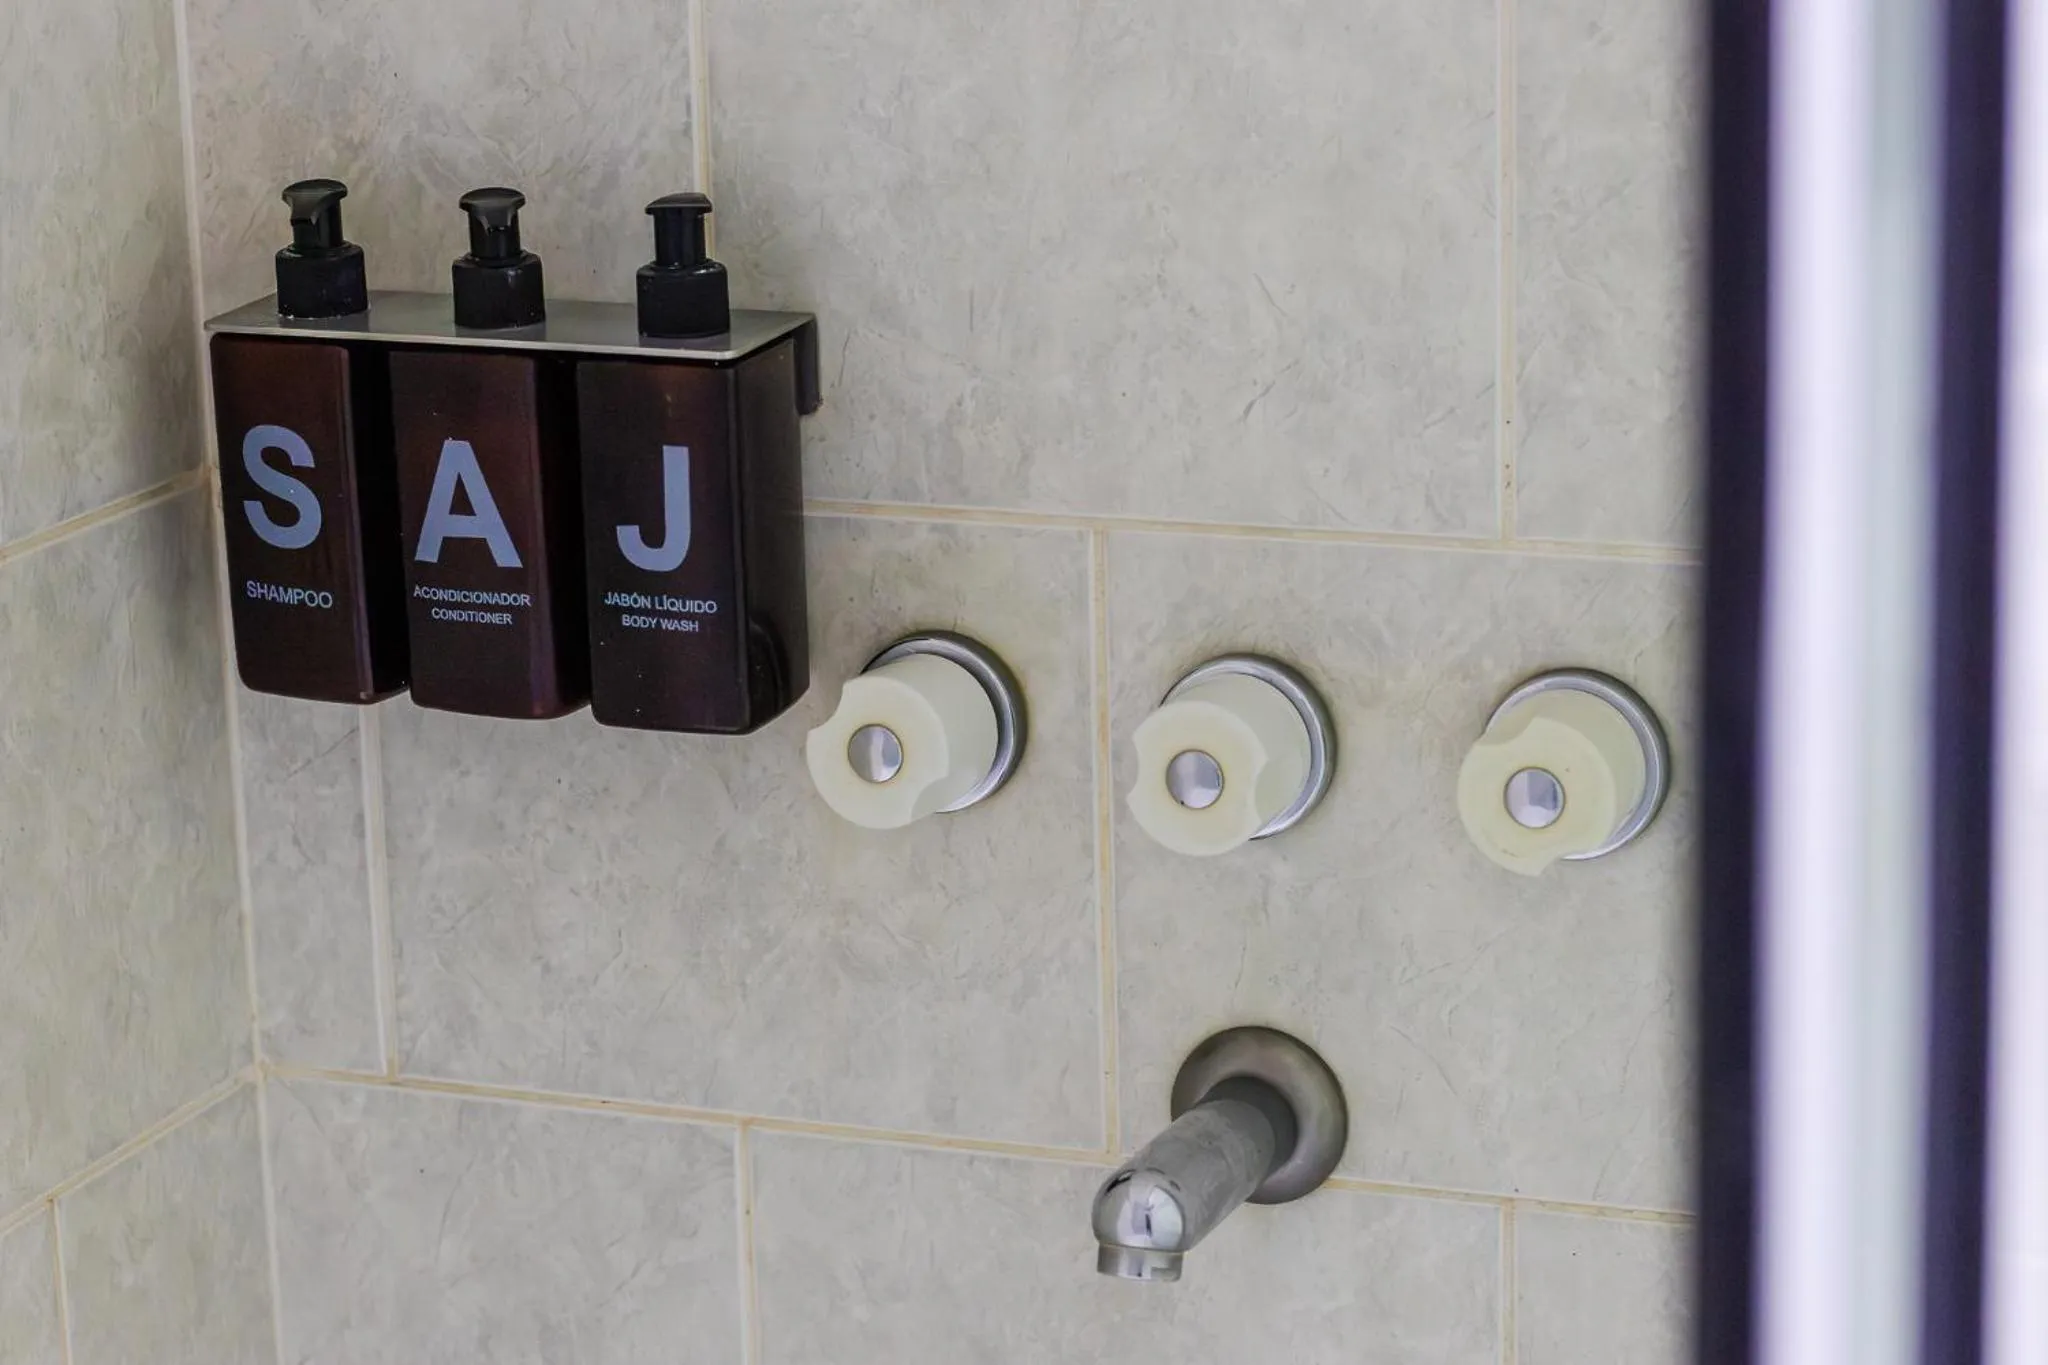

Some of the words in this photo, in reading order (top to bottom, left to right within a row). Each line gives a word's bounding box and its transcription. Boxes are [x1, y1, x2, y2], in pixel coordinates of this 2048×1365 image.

[242, 425, 322, 549] S
[414, 437, 523, 569] A
[616, 444, 692, 572] J
[246, 580, 333, 609] SHAMPOO
[413, 585, 532, 607] ACONDICIONADOR
[604, 591, 652, 609] JABÓN
[654, 594, 718, 614] LÍQUIDO
[431, 607, 513, 625] CONDITIONER
[622, 613, 658, 629] BODY
[659, 617, 699, 633] WASH
